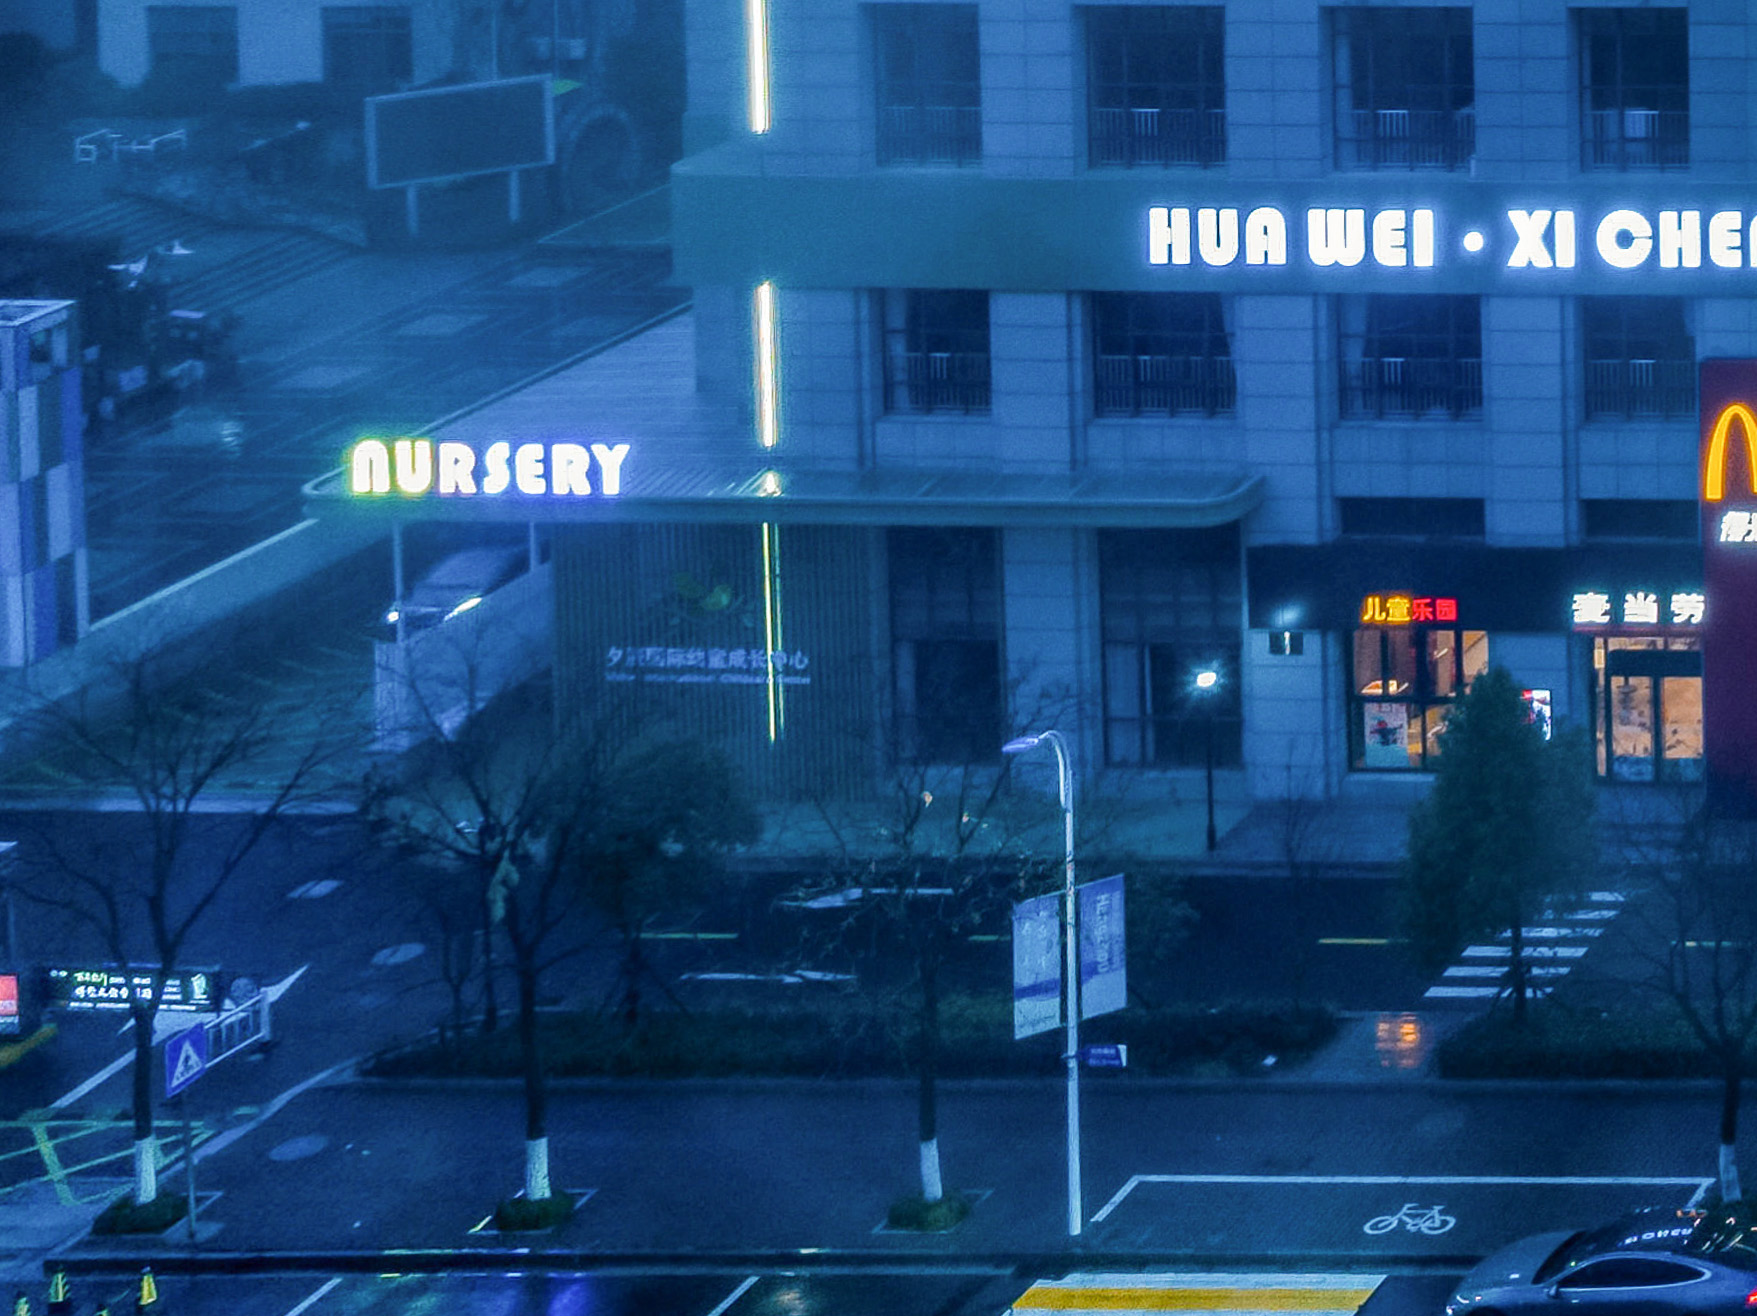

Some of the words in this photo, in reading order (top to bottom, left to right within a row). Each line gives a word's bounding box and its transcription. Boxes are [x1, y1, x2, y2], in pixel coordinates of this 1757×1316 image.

[1148, 207, 1287, 266] HUA
[1306, 208, 1434, 267] WEI
[1506, 210, 1577, 268] XI
[351, 439, 632, 496] NURSERY
[1362, 596, 1457, 622] 儿童乐园
[1571, 591, 1705, 624] 麦当劳
